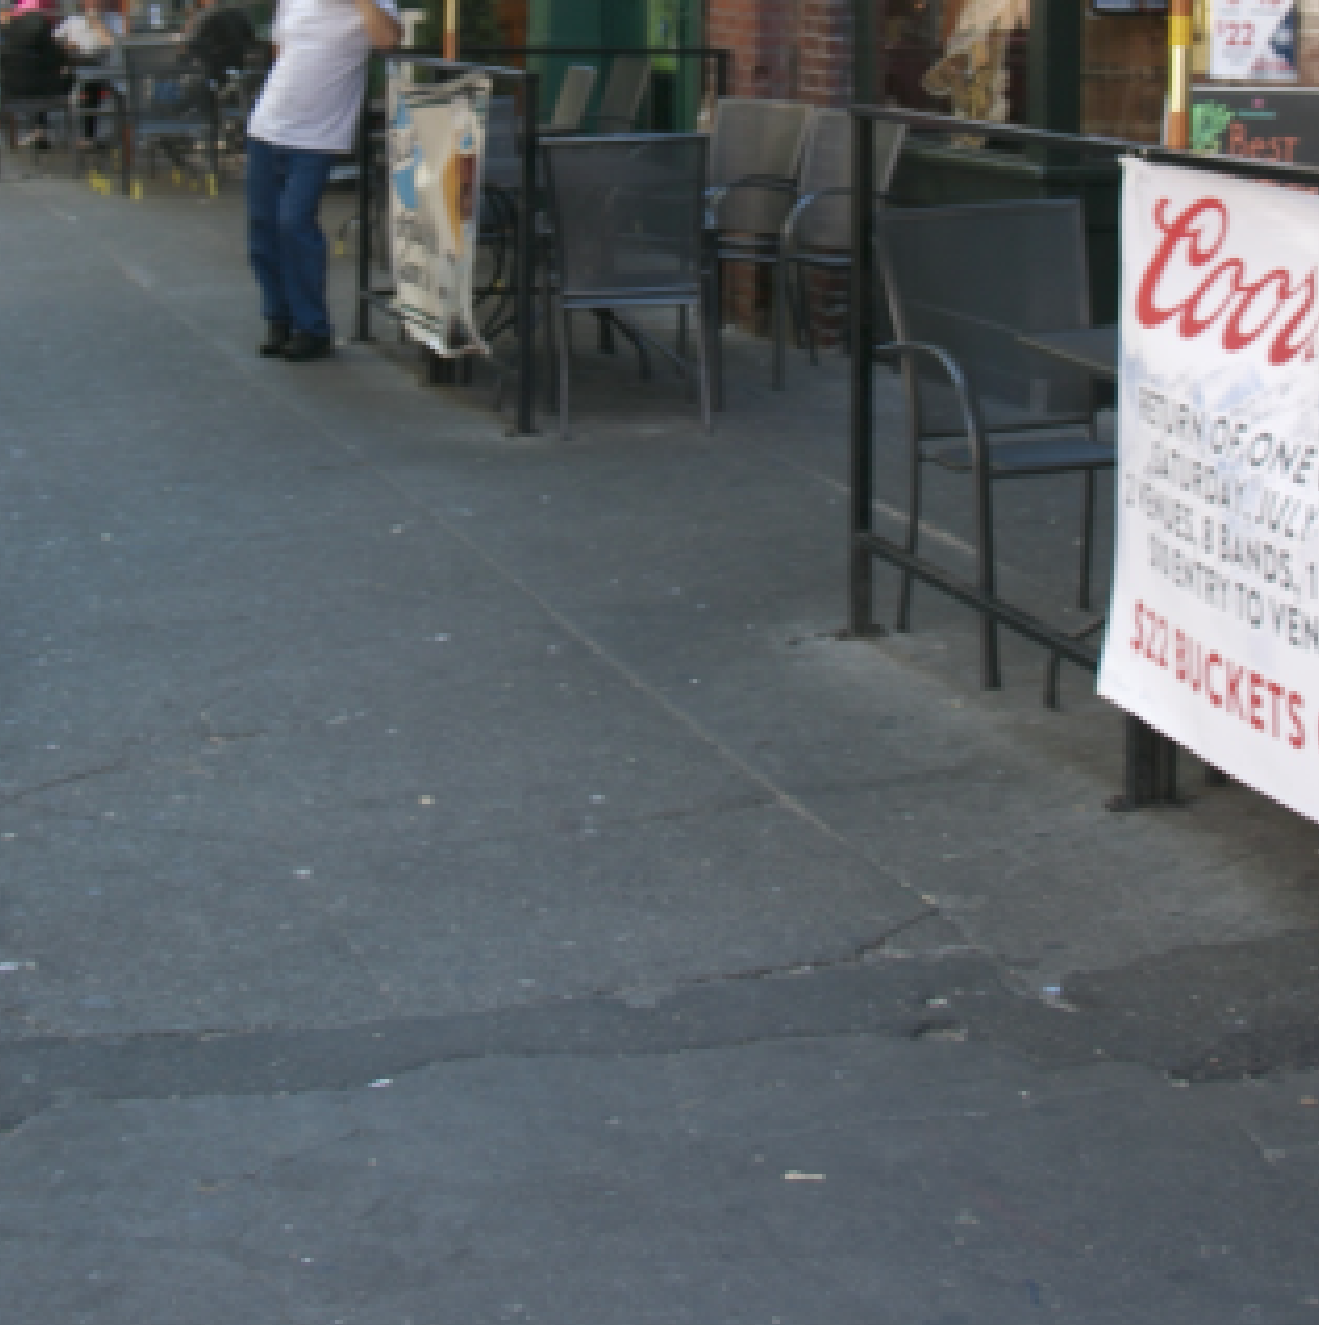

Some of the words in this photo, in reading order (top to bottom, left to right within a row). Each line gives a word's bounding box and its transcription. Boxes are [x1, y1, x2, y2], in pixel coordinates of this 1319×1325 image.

[1209, 414, 1248, 458] OF
[1249, 431, 1318, 485] ONE
[1235, 580, 1266, 631] TO
[1174, 628, 1308, 752] BUCKETS
